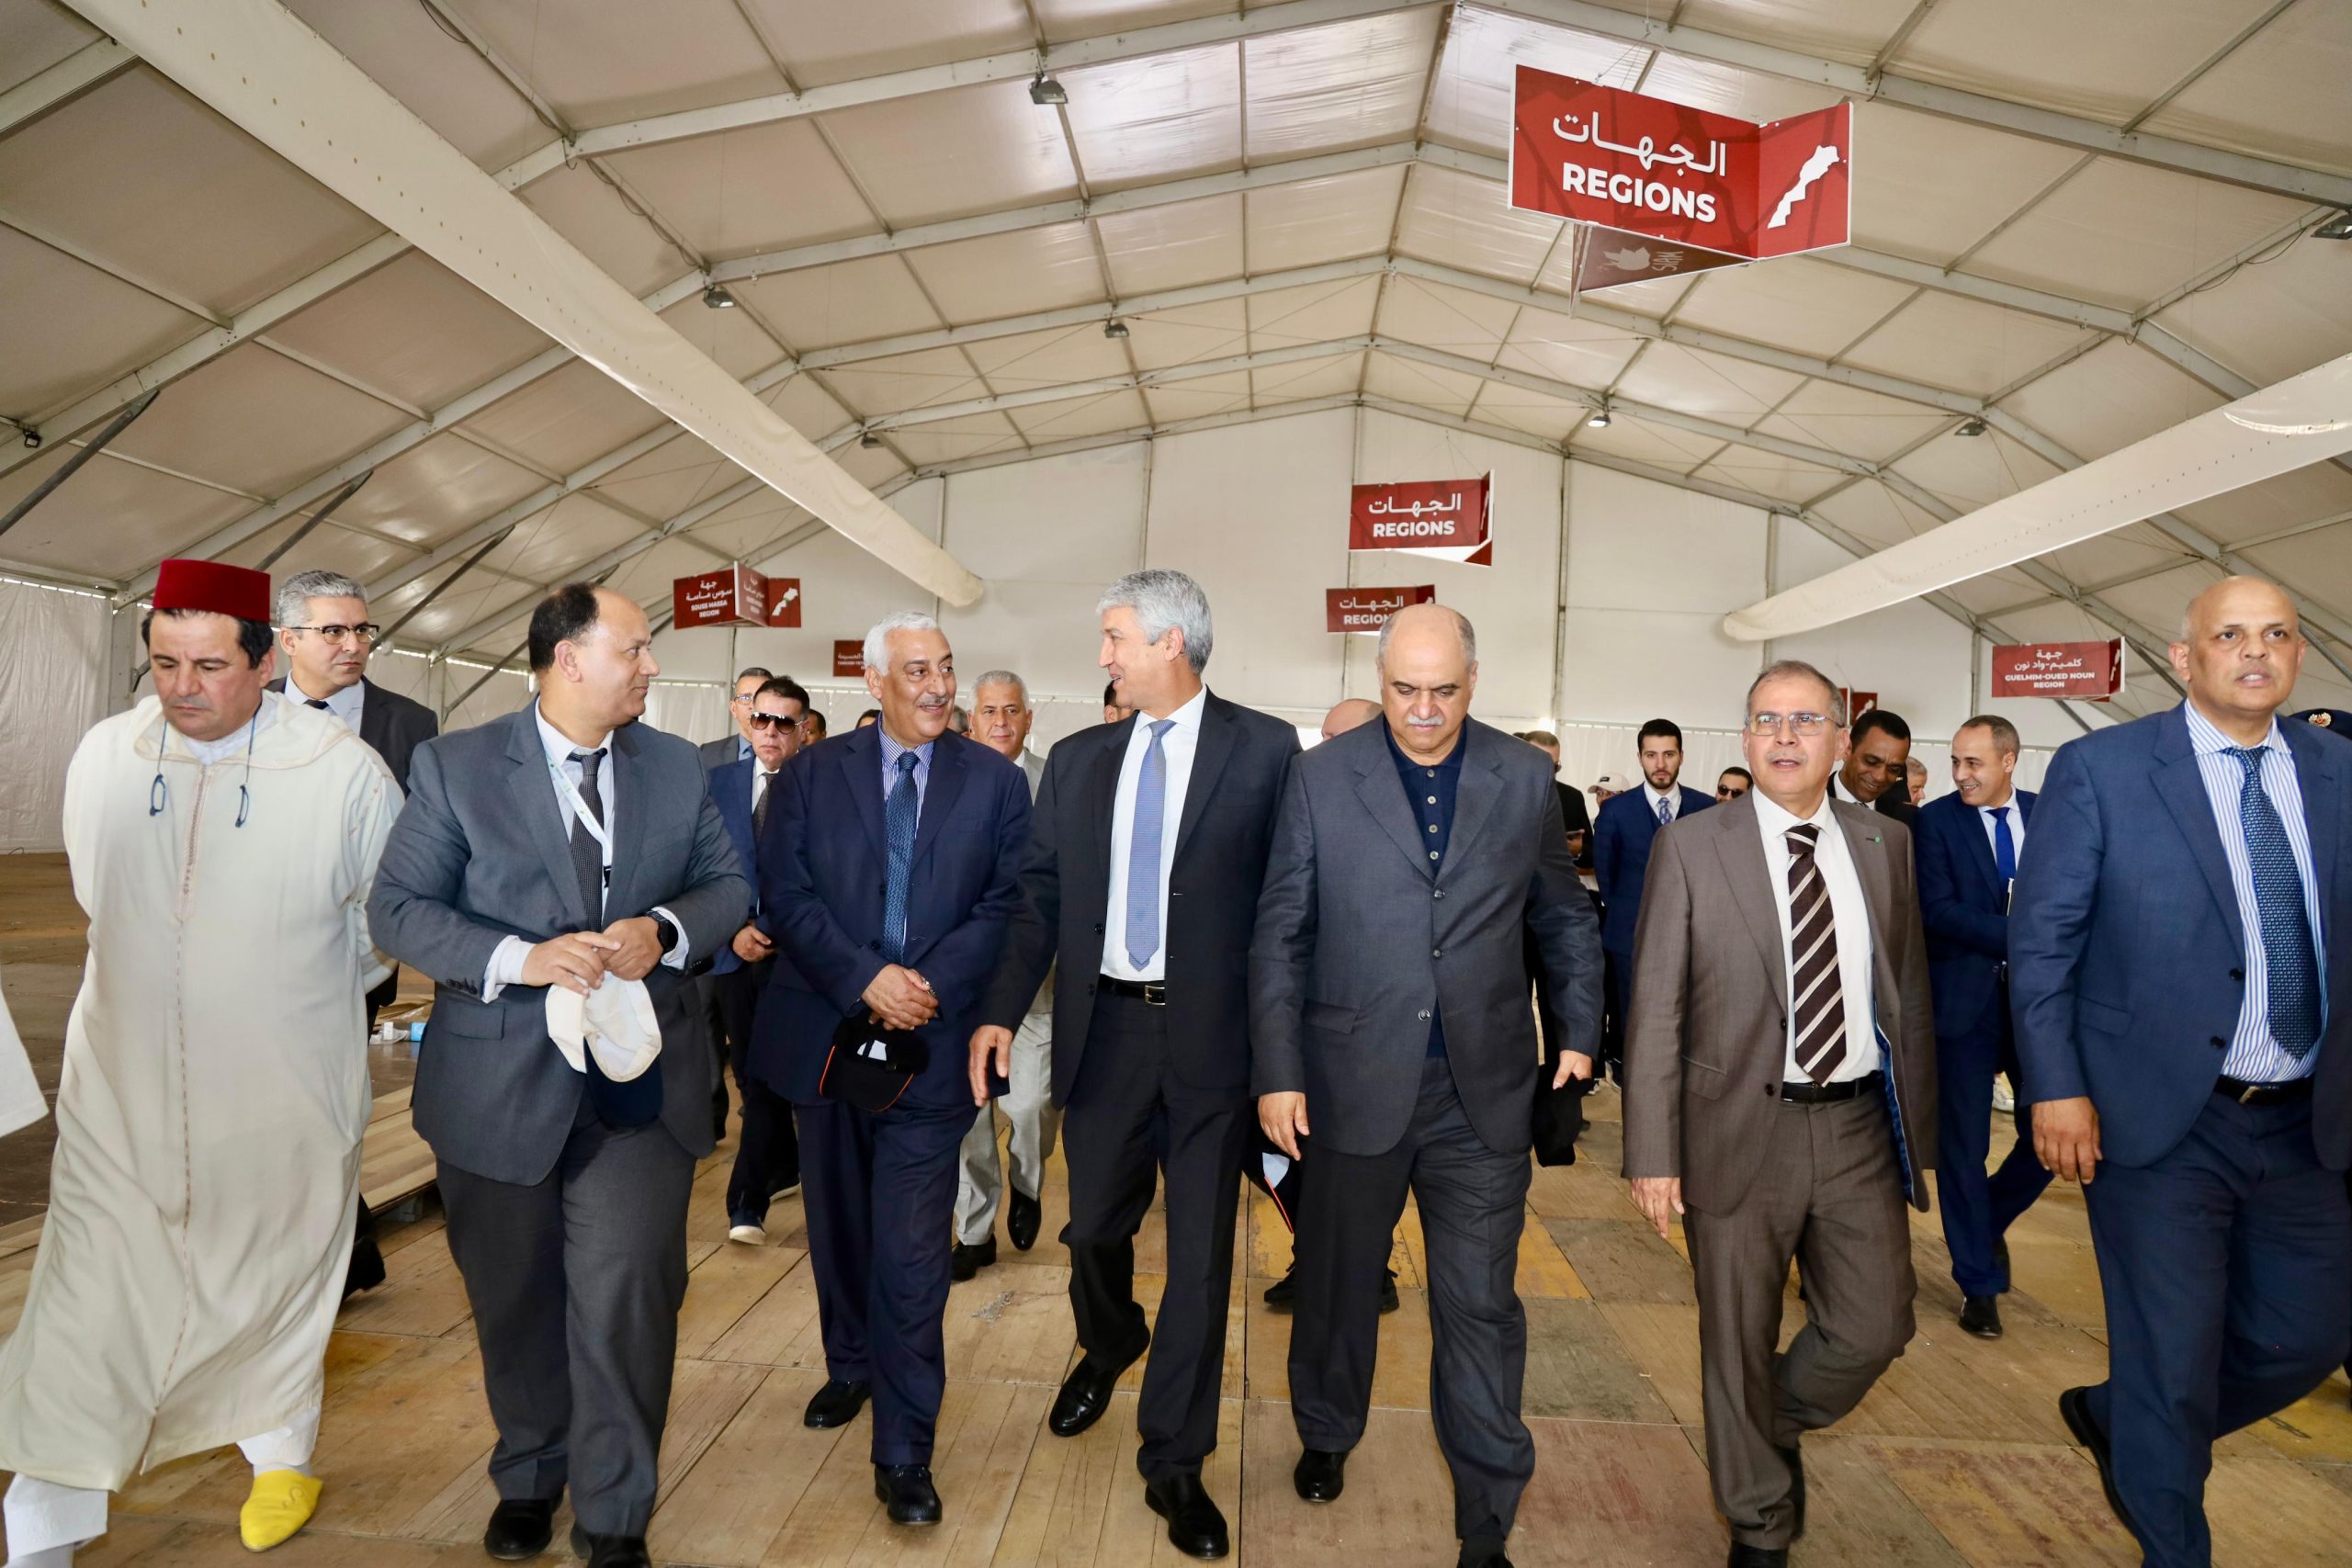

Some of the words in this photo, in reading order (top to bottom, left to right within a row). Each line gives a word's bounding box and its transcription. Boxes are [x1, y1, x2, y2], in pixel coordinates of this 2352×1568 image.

[1552, 111, 1726, 177] الجهات
[1562, 162, 1716, 223] REGIONS
[1651, 251, 1684, 272] SIAM
[1368, 492, 1462, 518] الجهات
[1373, 520, 1455, 537] REGIONS
[1339, 595, 1404, 612] الجهات
[2036, 649, 2064, 660] جهة
[2014, 661, 2030, 671] نون
[2069, 671, 2095, 680] NOUN
[2033, 681, 2065, 689] REGION
